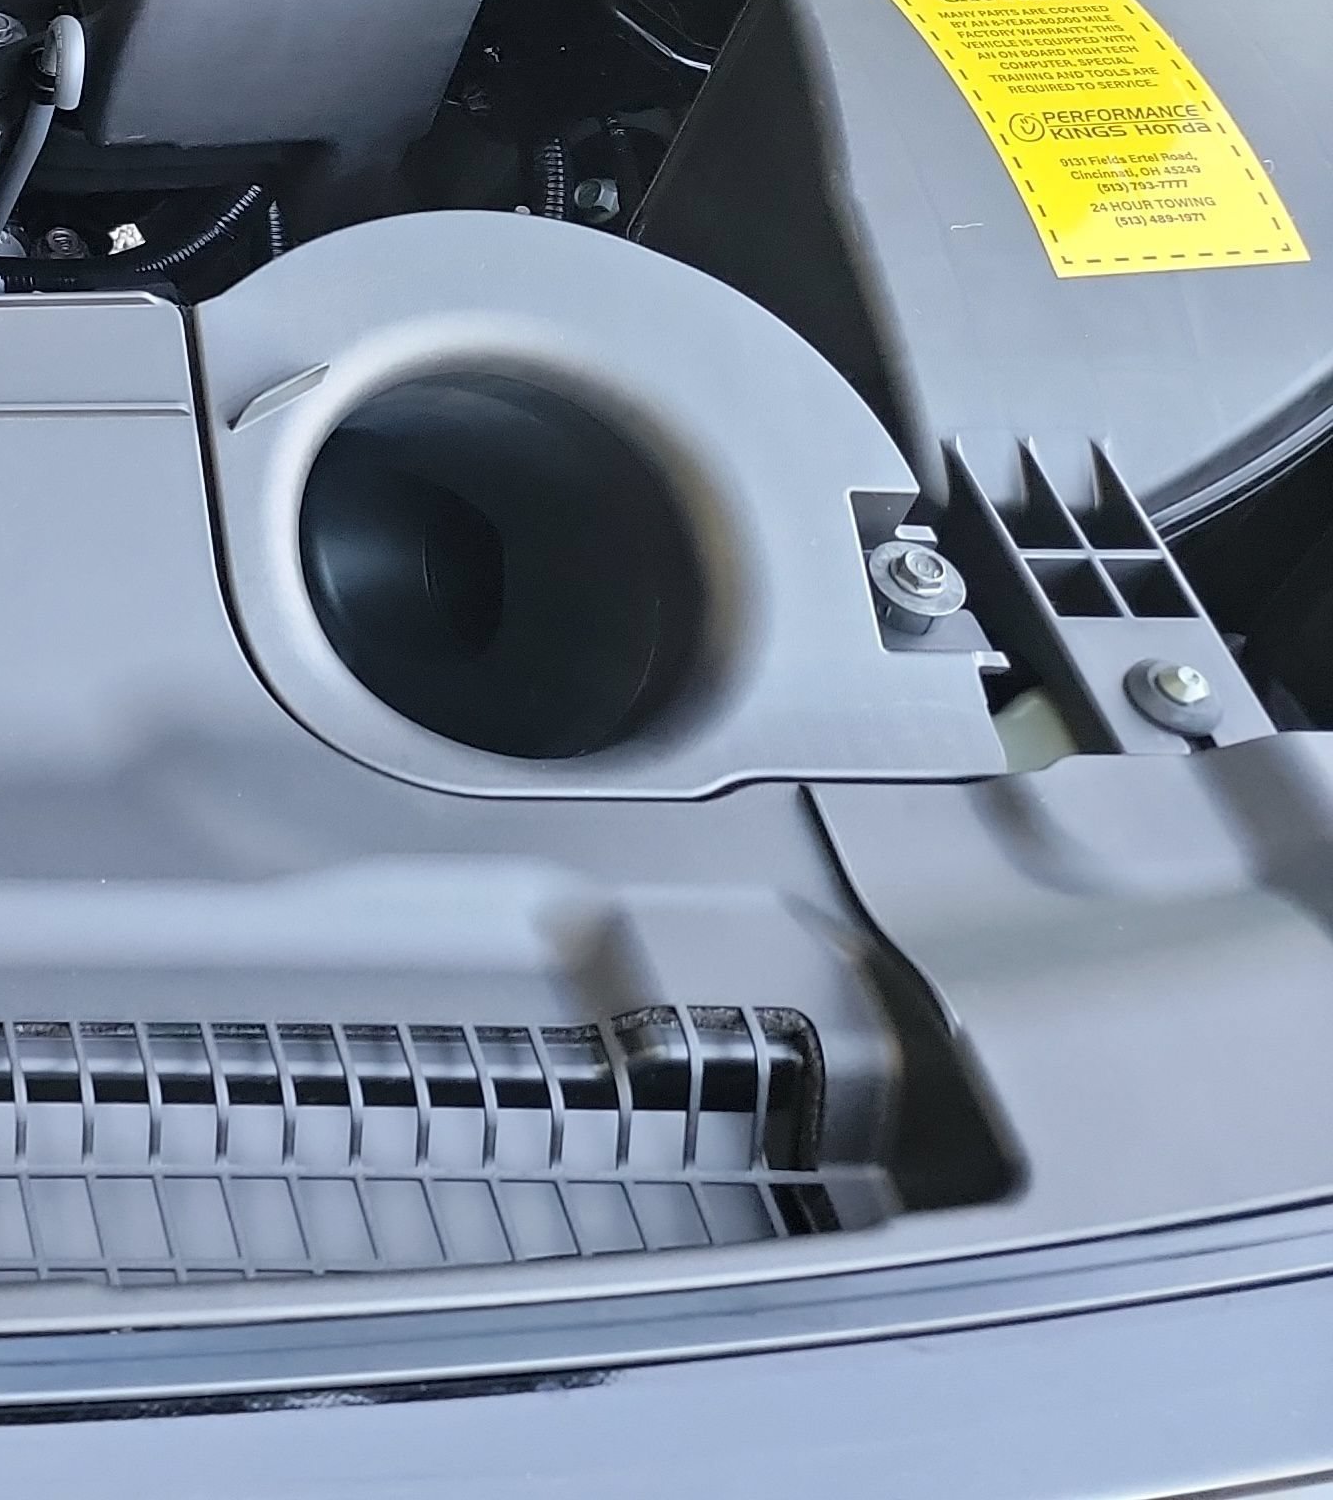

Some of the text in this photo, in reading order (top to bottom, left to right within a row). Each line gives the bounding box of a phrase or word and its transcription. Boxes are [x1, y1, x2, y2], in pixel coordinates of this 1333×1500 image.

[938, 5, 1109, 19] MANY PARTS ARE COVERED
[950, 21, 968, 29] BY
[1081, 14, 1115, 22] MILE
[957, 29, 1015, 39] FACTORY
[1095, 24, 1125, 32] THIS
[961, 35, 1136, 49] VEHICLE IS EQUIPPED WITH
[978, 45, 1139, 60] AN ON BOARD HIGH TECH
[1080, 57, 1134, 66] SPECIAL
[989, 67, 1160, 83] TRAINING AND TOOLS ARE
[1008, 84, 1075, 94] REQUIRED
[1076, 82, 1096, 91] TO
[1042, 105, 1200, 124] PERFORMANCE
[1049, 122, 1212, 140] KINGS Honda
[1060, 152, 1197, 167] 9131 Fields Ertel Road,
[1070, 165, 1202, 180] Cincinnati, OH 45249
[1097, 179, 1188, 194] (513) 793-7777
[1090, 197, 1217, 213] 24 HOUR TOWING
[1115, 212, 1206, 227] (513) 489-1971
